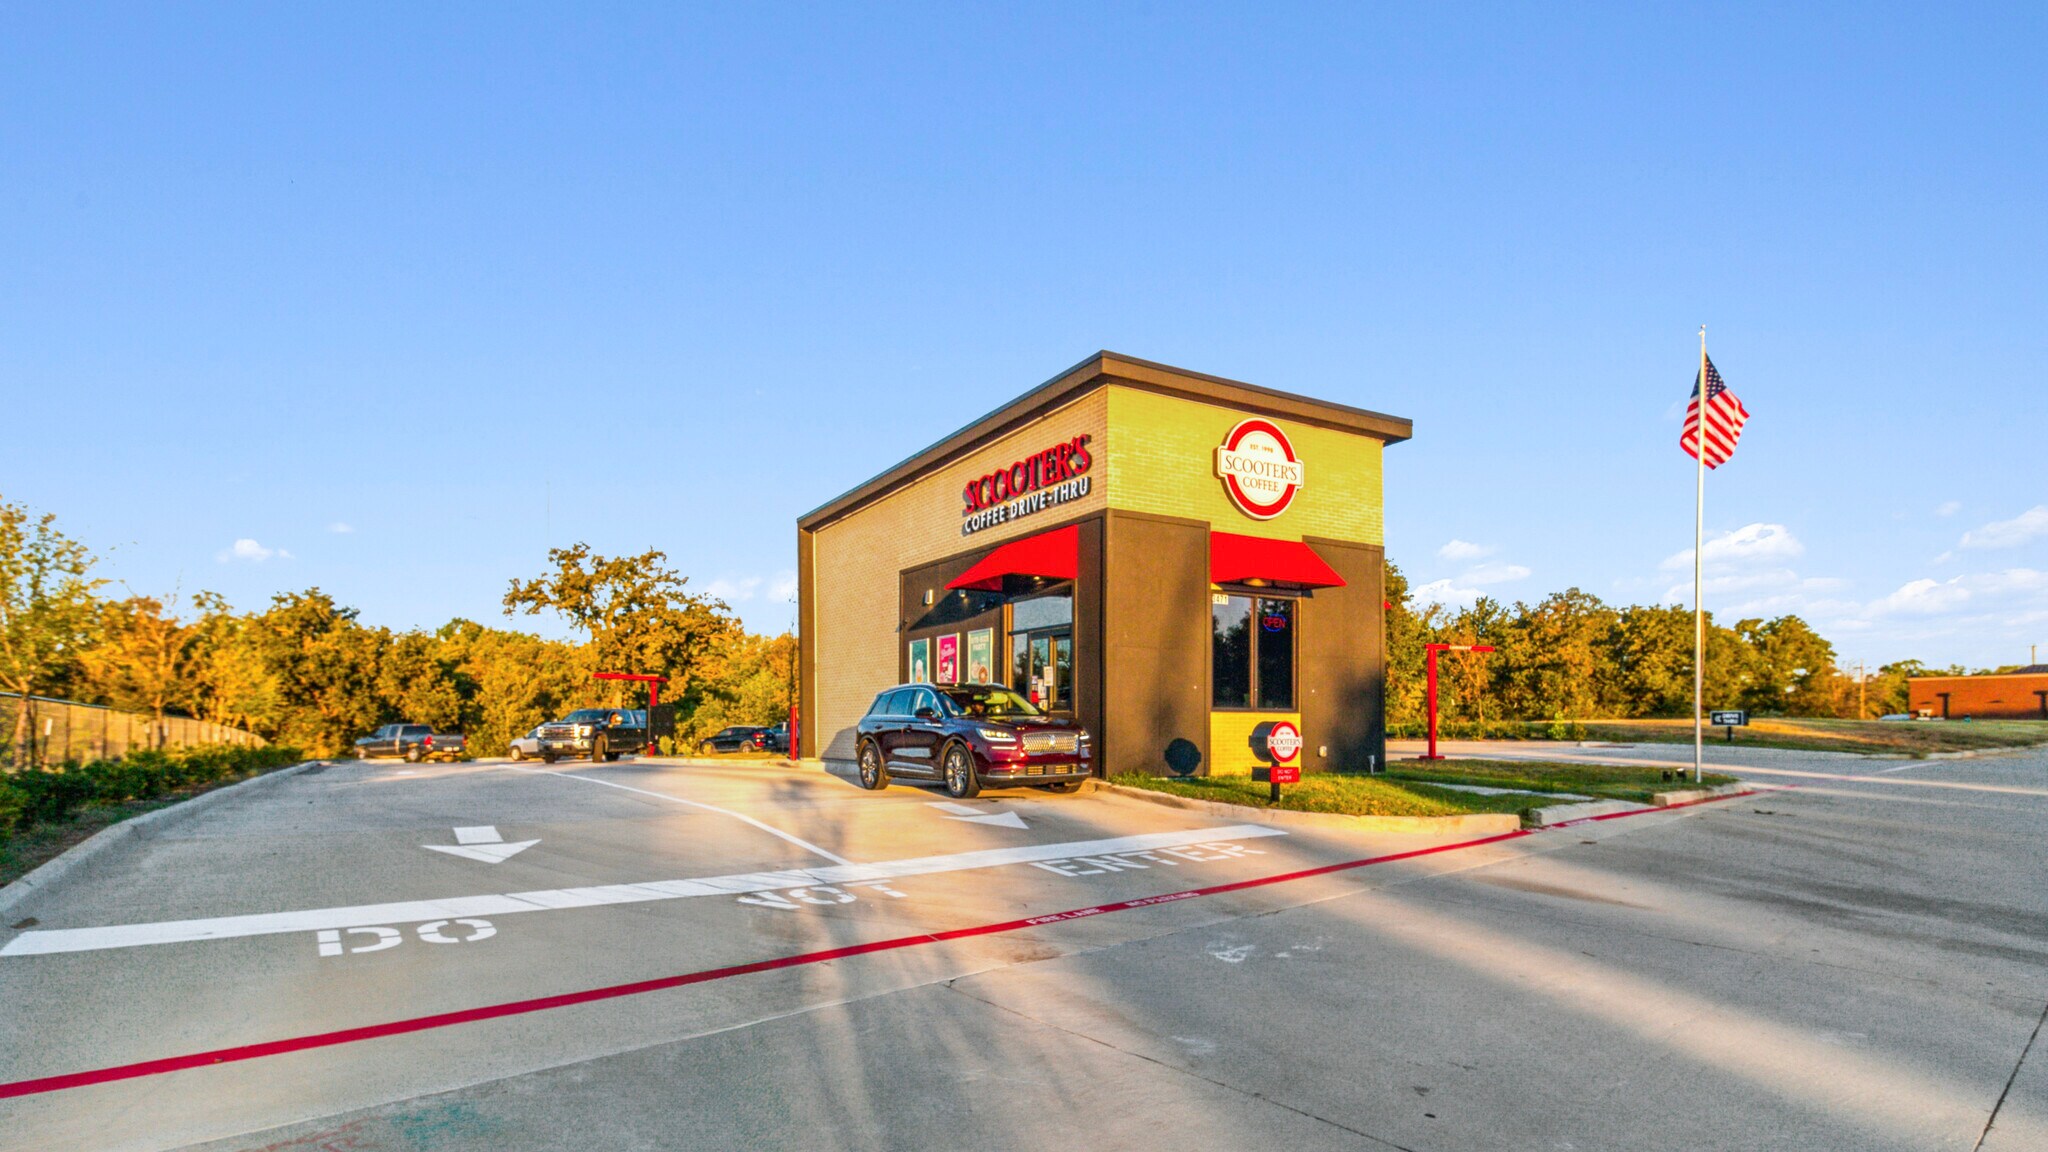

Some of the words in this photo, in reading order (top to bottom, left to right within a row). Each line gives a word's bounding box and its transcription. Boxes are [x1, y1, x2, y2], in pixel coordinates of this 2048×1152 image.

[965, 433, 1091, 514] SCOOTER'S
[1225, 454, 1298, 481] SCOOTER'S
[1242, 475, 1280, 493] COFFEE
[964, 506, 1006, 533] COFFEE
[1009, 476, 1090, 519] DRIVE-THRU
[1263, 615, 1286, 629] OPEN
[1269, 738, 1301, 746] SCOOTER'S
[317, 918, 497, 957] DO
[737, 879, 908, 910] NOT
[1027, 842, 1267, 877] ENTER
